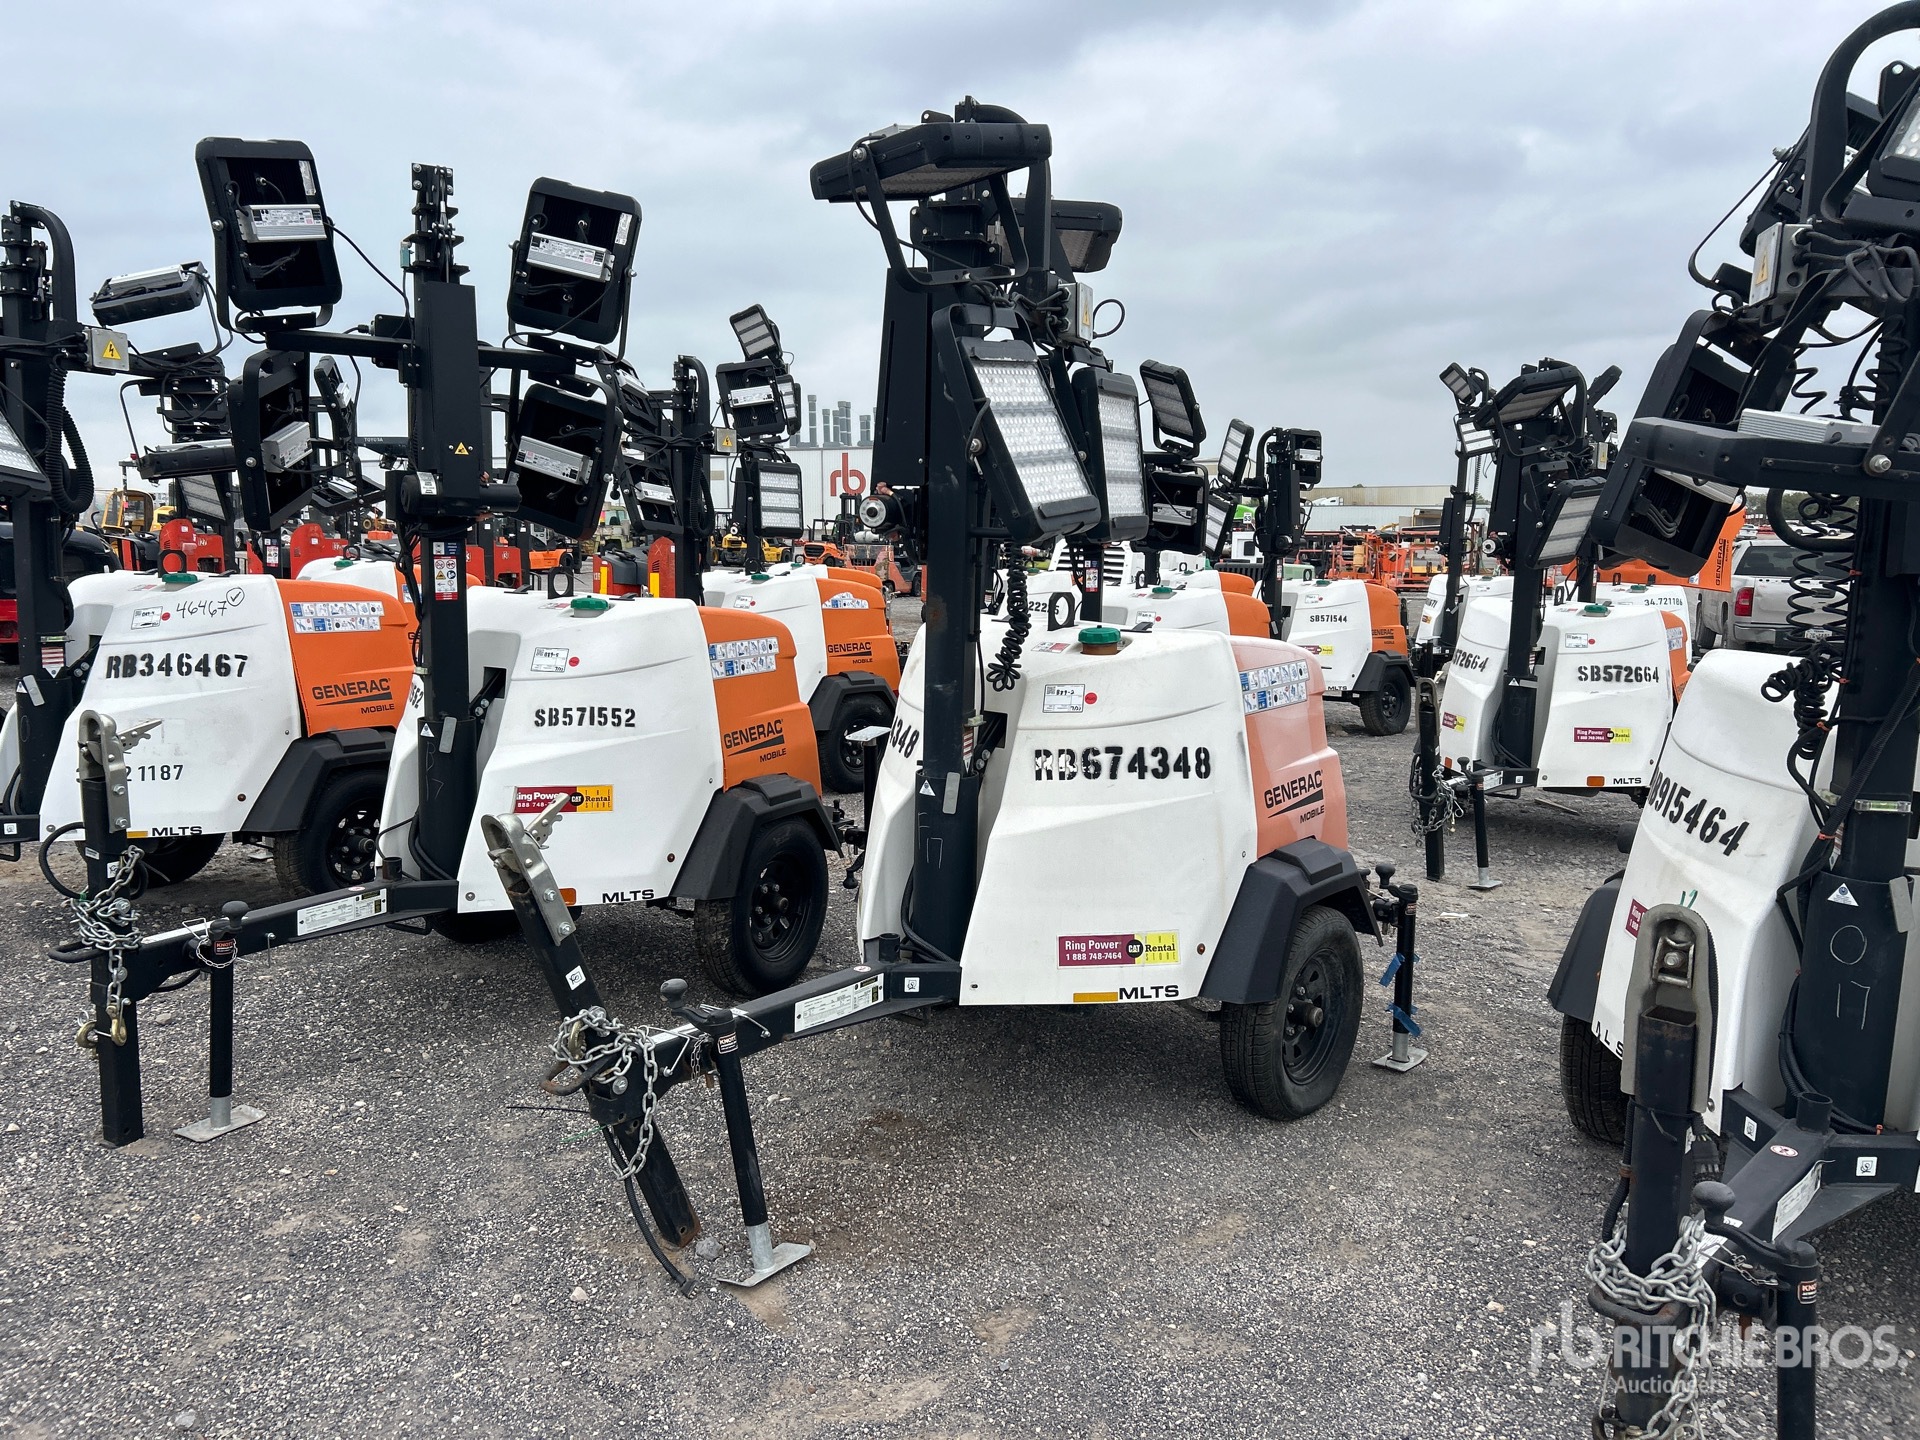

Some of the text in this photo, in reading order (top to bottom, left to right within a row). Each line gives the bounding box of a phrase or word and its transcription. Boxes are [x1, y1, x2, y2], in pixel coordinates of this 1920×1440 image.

[830, 452, 866, 496] rb
[1715, 538, 1723, 586] GENERAC
[176, 600, 228, 618] 46467
[828, 642, 871, 653] GENERAC
[106, 653, 248, 678] RB346467
[1577, 665, 1659, 682] SB572664
[312, 678, 391, 700] GENERAC
[361, 704, 395, 714] MOBILE
[534, 707, 636, 727] SB571552
[724, 719, 783, 749] GENERAC
[760, 748, 786, 763] MOBILE
[1034, 746, 1211, 781] RB674348
[1264, 770, 1323, 809] GENERAC
[1300, 805, 1325, 824] MOBILE
[152, 826, 203, 837] MLTS
[602, 889, 655, 903] MLTS
[1065, 940, 1119, 951] Ring Power
[1128, 944, 1141, 952] CAT
[1145, 943, 1176, 952] Rental
[1089, 952, 1122, 960] 748-7464
[1119, 985, 1179, 999] MLTS
